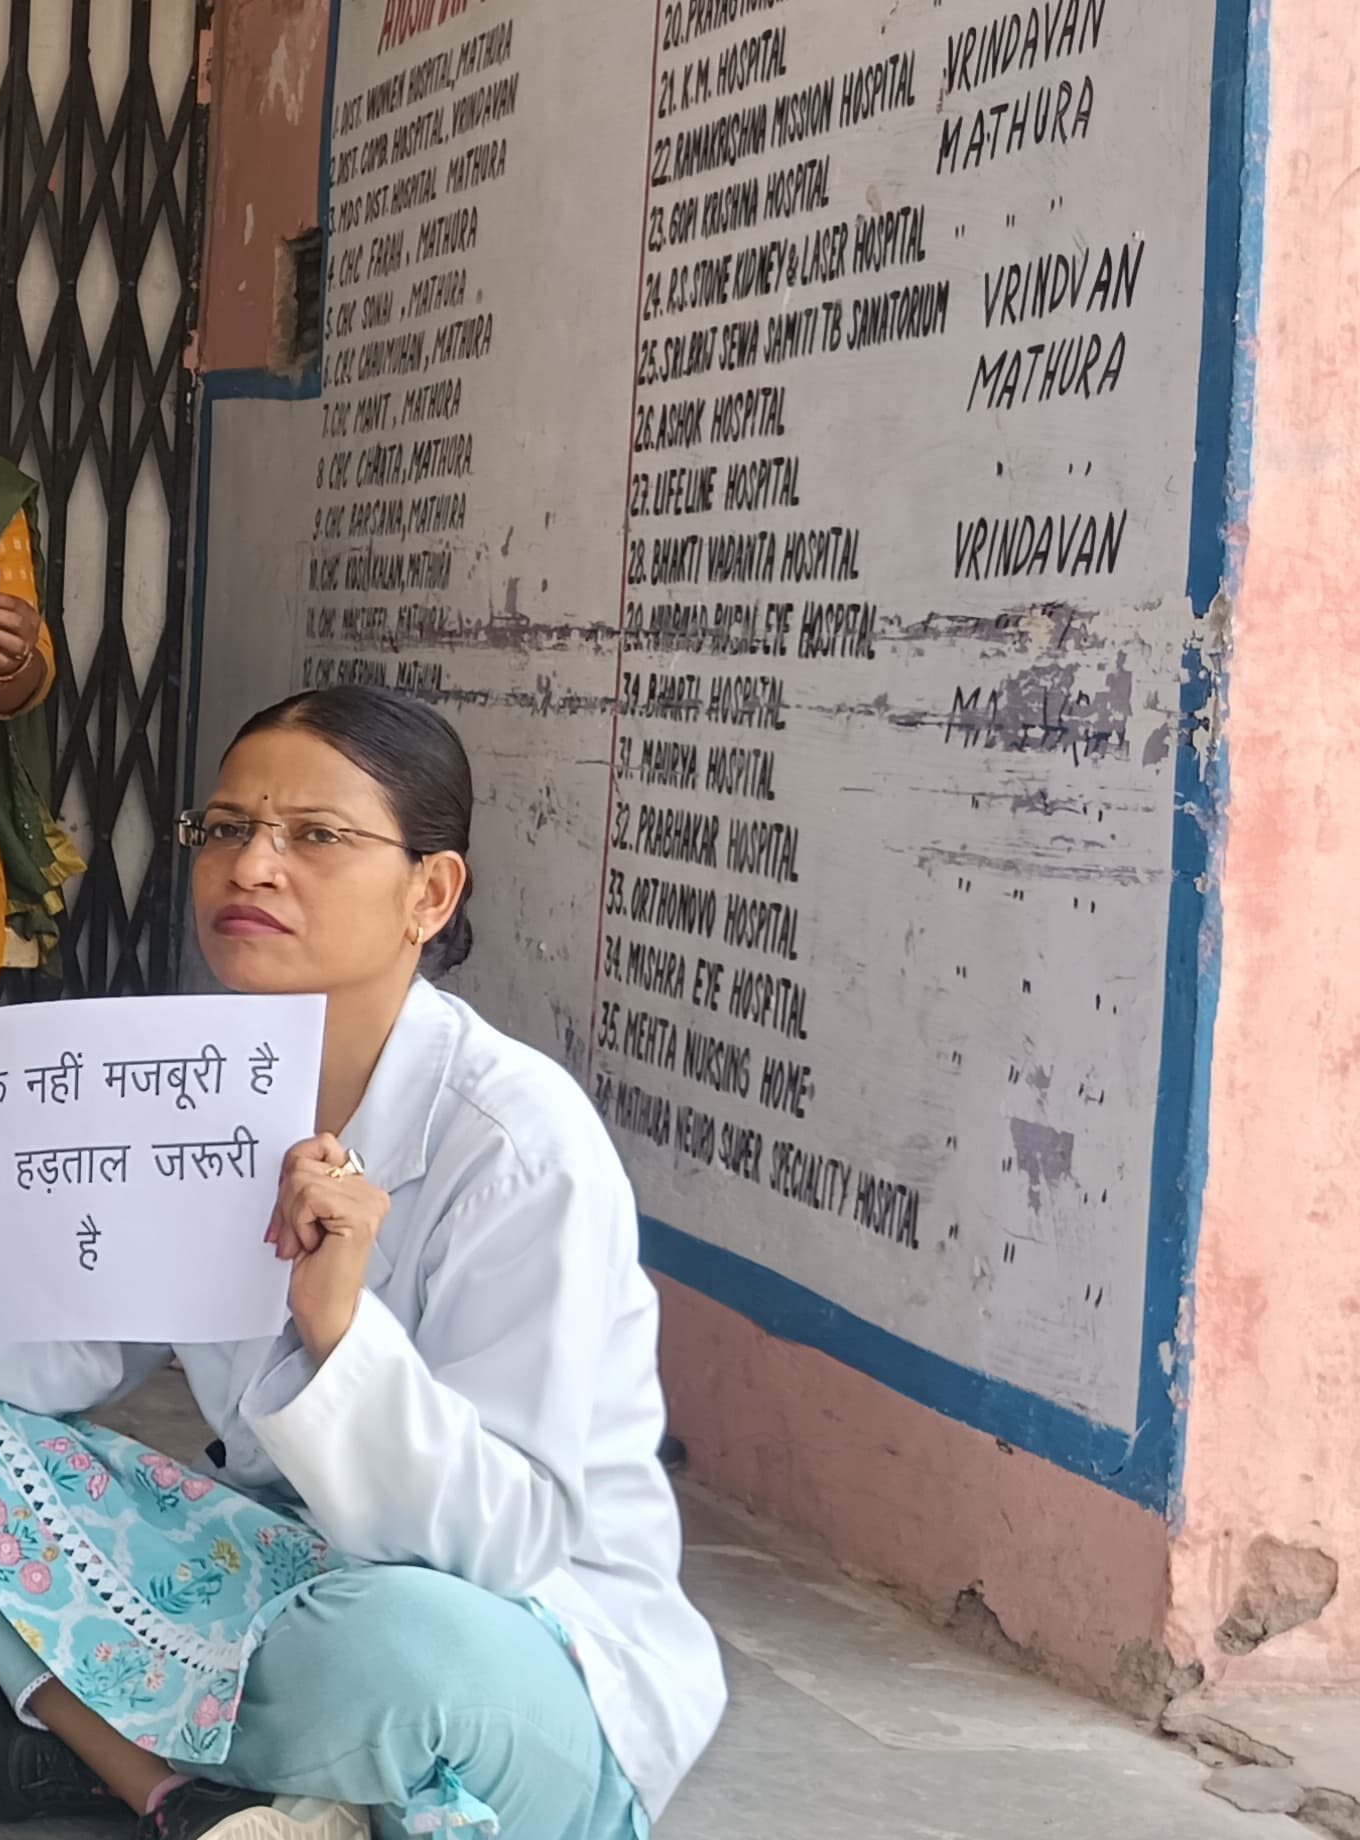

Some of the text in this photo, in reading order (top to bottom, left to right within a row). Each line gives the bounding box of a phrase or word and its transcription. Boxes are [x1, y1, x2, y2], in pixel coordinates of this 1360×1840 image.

[456, 18, 513, 81] MATHURA
[717, 26, 787, 97] HOSPITAL
[770, 75, 835, 149] MISSION
[839, 50, 916, 129] HOSPITAL
[944, 0, 1107, 95] VRINDAVAN
[446, 138, 506, 194] MATHURA
[763, 154, 830, 221] HOSPITAL
[936, 75, 1094, 176] MATHURA
[338, 243, 363, 288] CHC
[416, 206, 478, 264] MATHURA
[732, 237, 789, 301] KIDNEY
[786, 243, 799, 288] &
[800, 222, 849, 287] LASER
[852, 204, 926, 275] HOSPITAL
[336, 300, 358, 338] CHC
[407, 266, 467, 319] MATHURA
[718, 239, 1145, 372] SEWA SAMITI TB SANATORIUM VRINDVAN
[334, 348, 356, 387] CHC
[431, 312, 493, 366] MATHURA
[401, 377, 462, 426] MATHURA
[710, 386, 786, 444] HOSPITAL
[966, 331, 1127, 412] MATHURA
[329, 451, 353, 491] CHC
[407, 432, 473, 485] MATHURA
[723, 455, 800, 512] HOSPITAL
[324, 504, 346, 540] CHC
[407, 492, 467, 535] MATHURA
[650, 533, 704, 586] BHAKTI
[780, 525, 860, 584] HOSPITAL
[953, 507, 1127, 582] VRINDAVAN
[798, 600, 878, 661] HOSPITAL
[706, 675, 787, 731] HOSPITAL
[705, 745, 776, 801] HOSPITAL
[634, 804, 720, 869] PRABHAKAR
[726, 817, 799, 883] HOSPITAL
[723, 893, 799, 961] HOSPITAL
[625, 940, 686, 1000] MISHRA
[692, 958, 725, 1012] EYE
[728, 967, 808, 1041] HOSPITAL
[23, 1050, 84, 1104] नहीं
[102, 1043, 228, 1111] मजबूरी
[247, 1041, 280, 1096] है
[597, 1001, 620, 1052] 35.
[623, 1008, 678, 1072] MEHTA
[682, 1028, 752, 1099] NURSING
[14, 1144, 132, 1196] हड़ताल
[151, 1124, 260, 1181] जरूरी
[614, 1079, 671, 1148] MATHURA
[717, 1121, 762, 1184] SUPER
[768, 1140, 853, 1218] SPECIALITY
[853, 1170, 920, 1251] HOSPITAL
[75, 1213, 103, 1271] है
